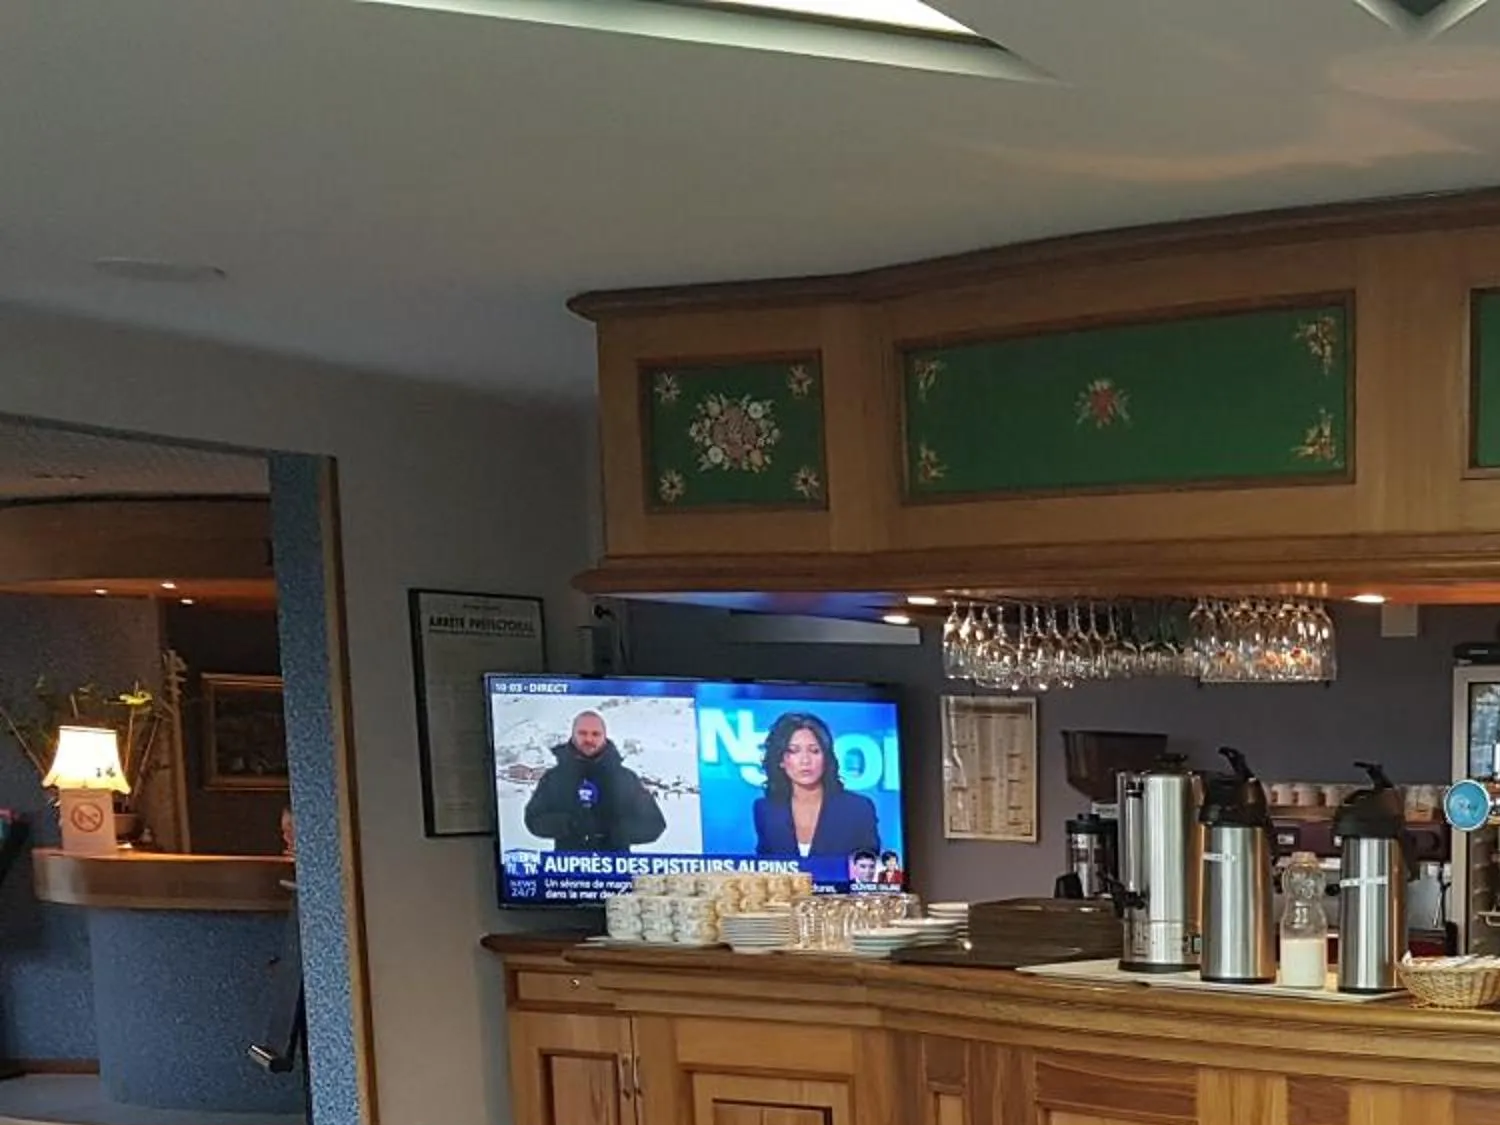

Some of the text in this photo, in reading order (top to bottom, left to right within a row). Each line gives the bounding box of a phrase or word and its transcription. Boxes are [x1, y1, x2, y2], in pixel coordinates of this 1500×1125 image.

[528, 683, 568, 693] DIRECT
[544, 852, 612, 873] AUPRÈS
[615, 857, 650, 874] DES
[654, 857, 736, 875] PISTEURS
